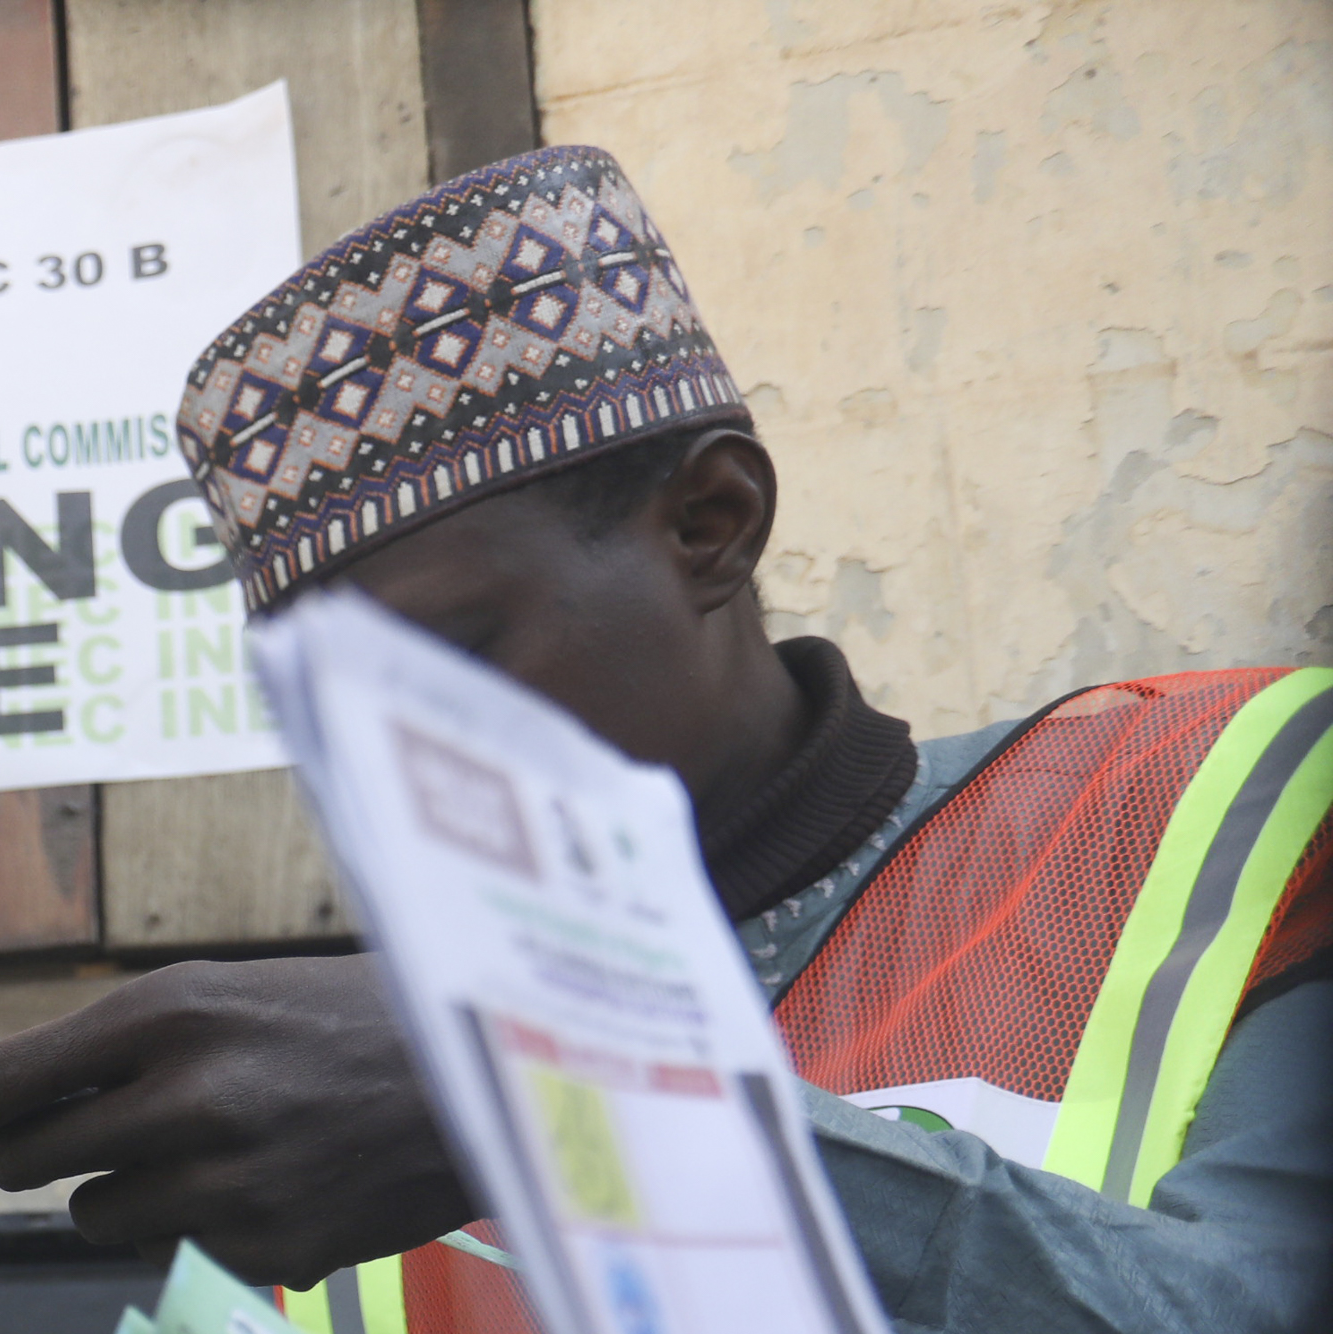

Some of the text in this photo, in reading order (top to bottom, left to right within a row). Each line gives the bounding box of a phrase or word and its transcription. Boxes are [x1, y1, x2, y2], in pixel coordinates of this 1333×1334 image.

[38, 250, 104, 292] 30
[133, 242, 170, 281] B
[23, 412, 176, 469] COMMIS
